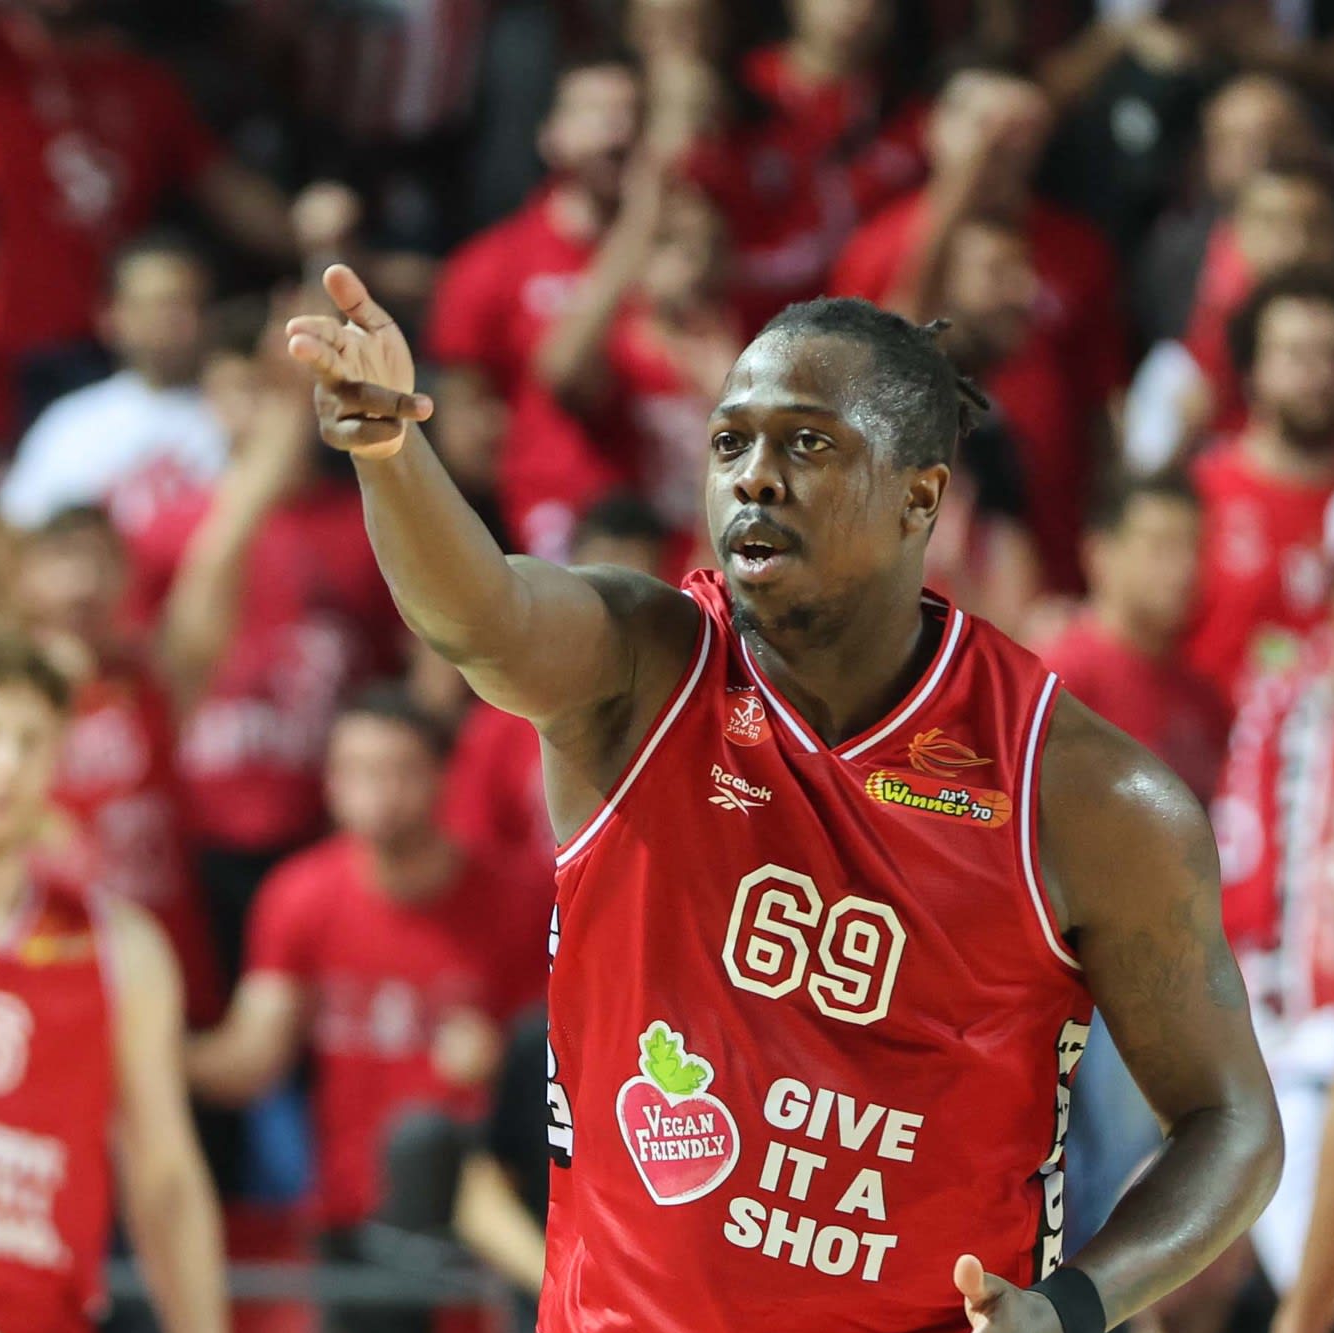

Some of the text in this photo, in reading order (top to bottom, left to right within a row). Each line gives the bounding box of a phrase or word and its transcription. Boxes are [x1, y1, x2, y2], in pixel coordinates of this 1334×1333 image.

[710, 764, 772, 801] Reebok
[882, 779, 970, 817] Winner
[938, 788, 969, 805] ליגת
[971, 803, 993, 820] סל
[722, 863, 907, 1026] 69
[764, 1077, 924, 1163] GIVE
[759, 1140, 887, 1221] IT A
[723, 1196, 898, 1282] SHOT
